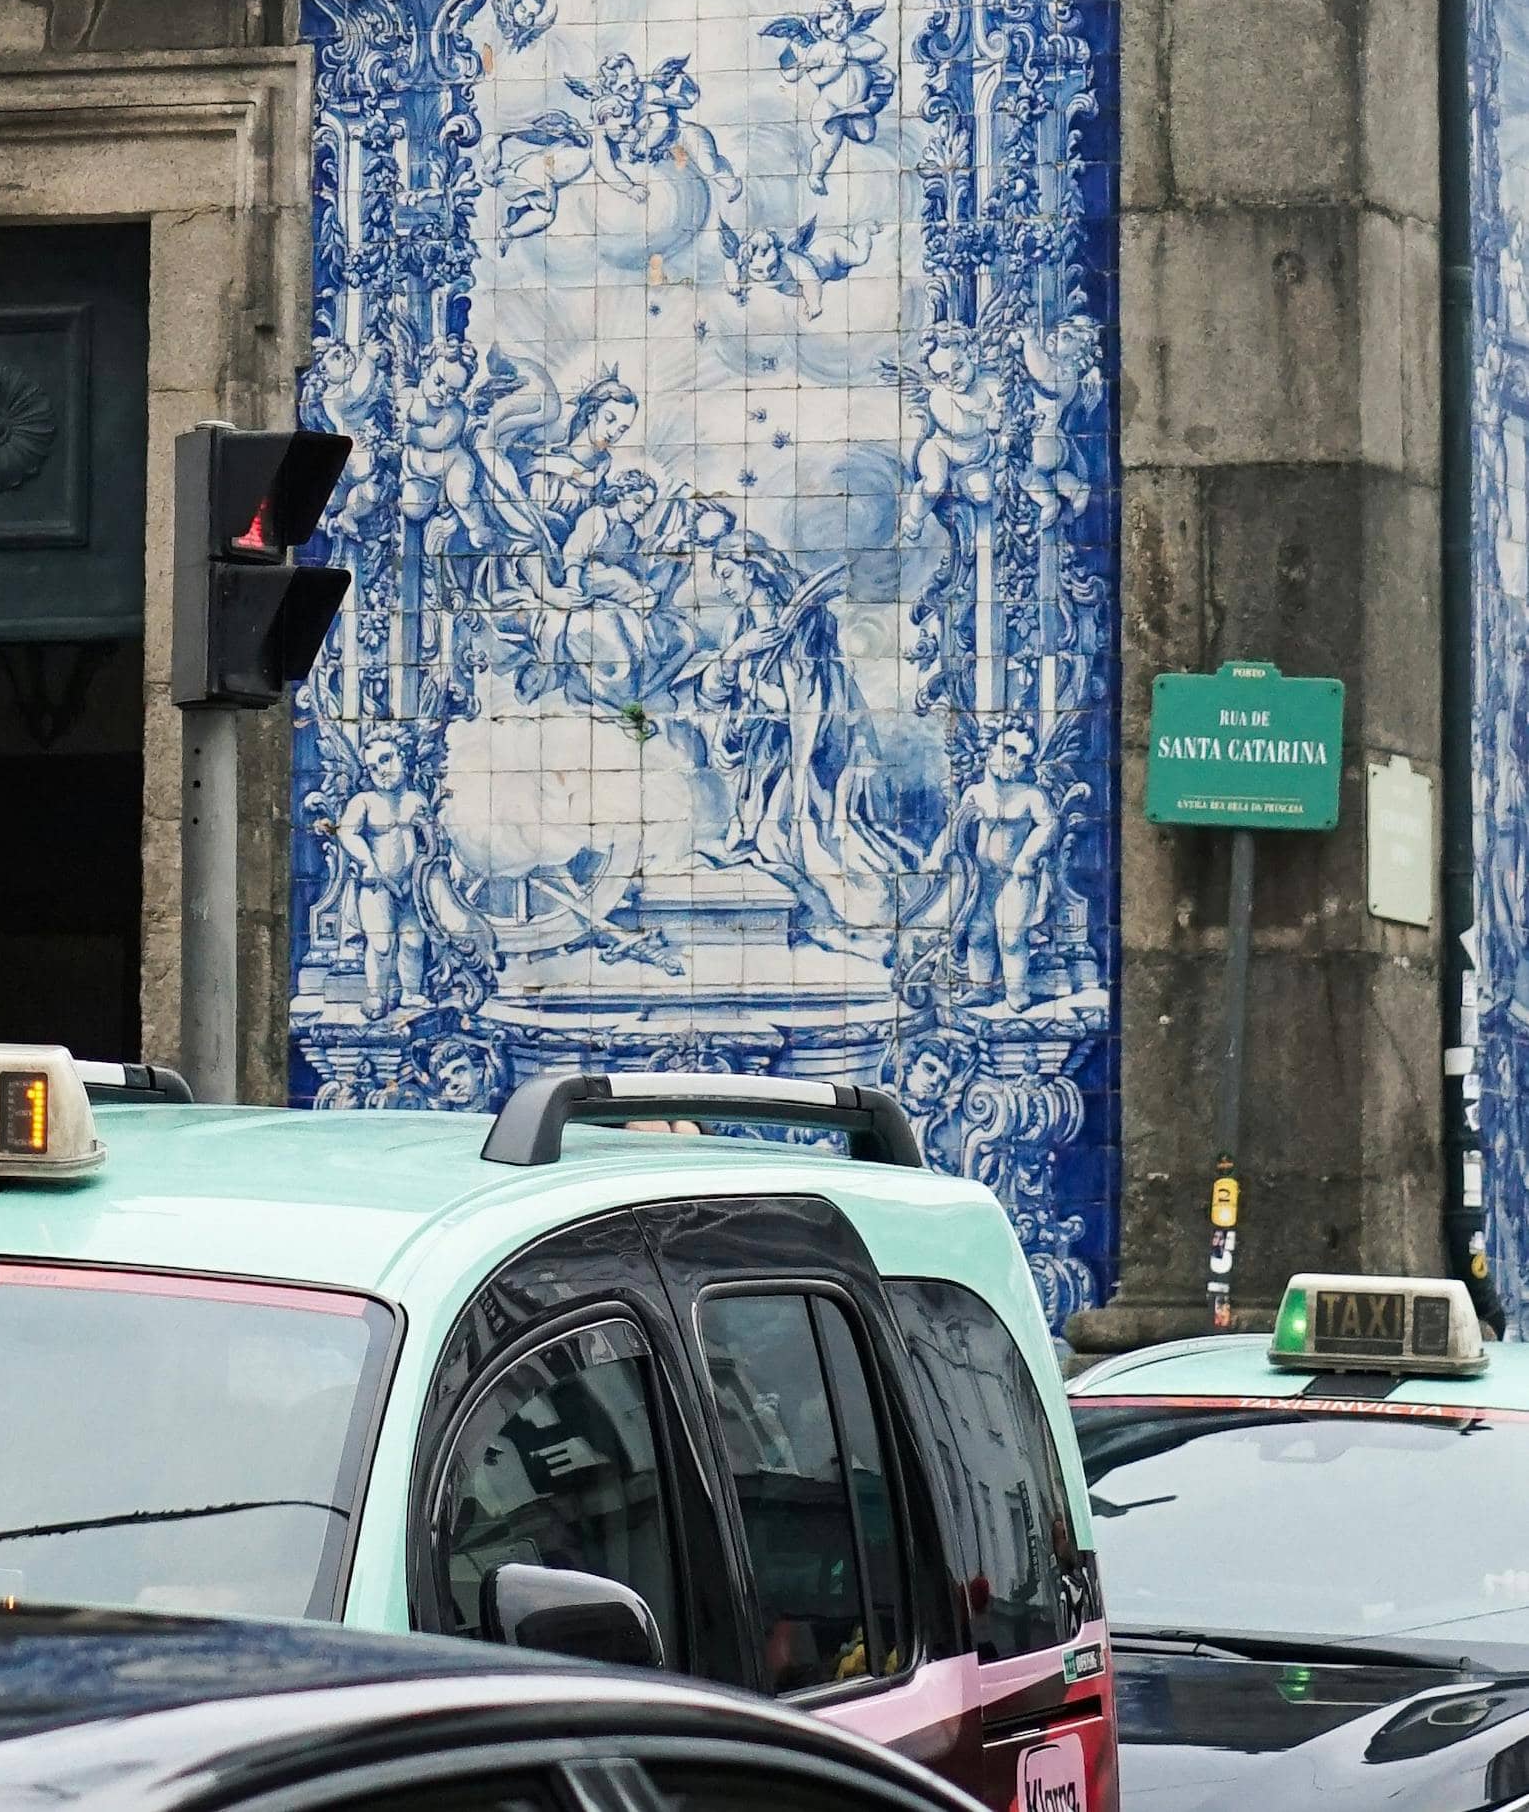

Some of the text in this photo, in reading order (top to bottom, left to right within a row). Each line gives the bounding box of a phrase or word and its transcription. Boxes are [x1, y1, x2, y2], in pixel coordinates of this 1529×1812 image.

[1219, 709, 1271, 727] RUA DE
[1157, 735, 1328, 765] SANTA CATARINA
[1321, 1293, 1402, 1338] TAXI
[1239, 1397, 1443, 1417] TAXISINVICTA
